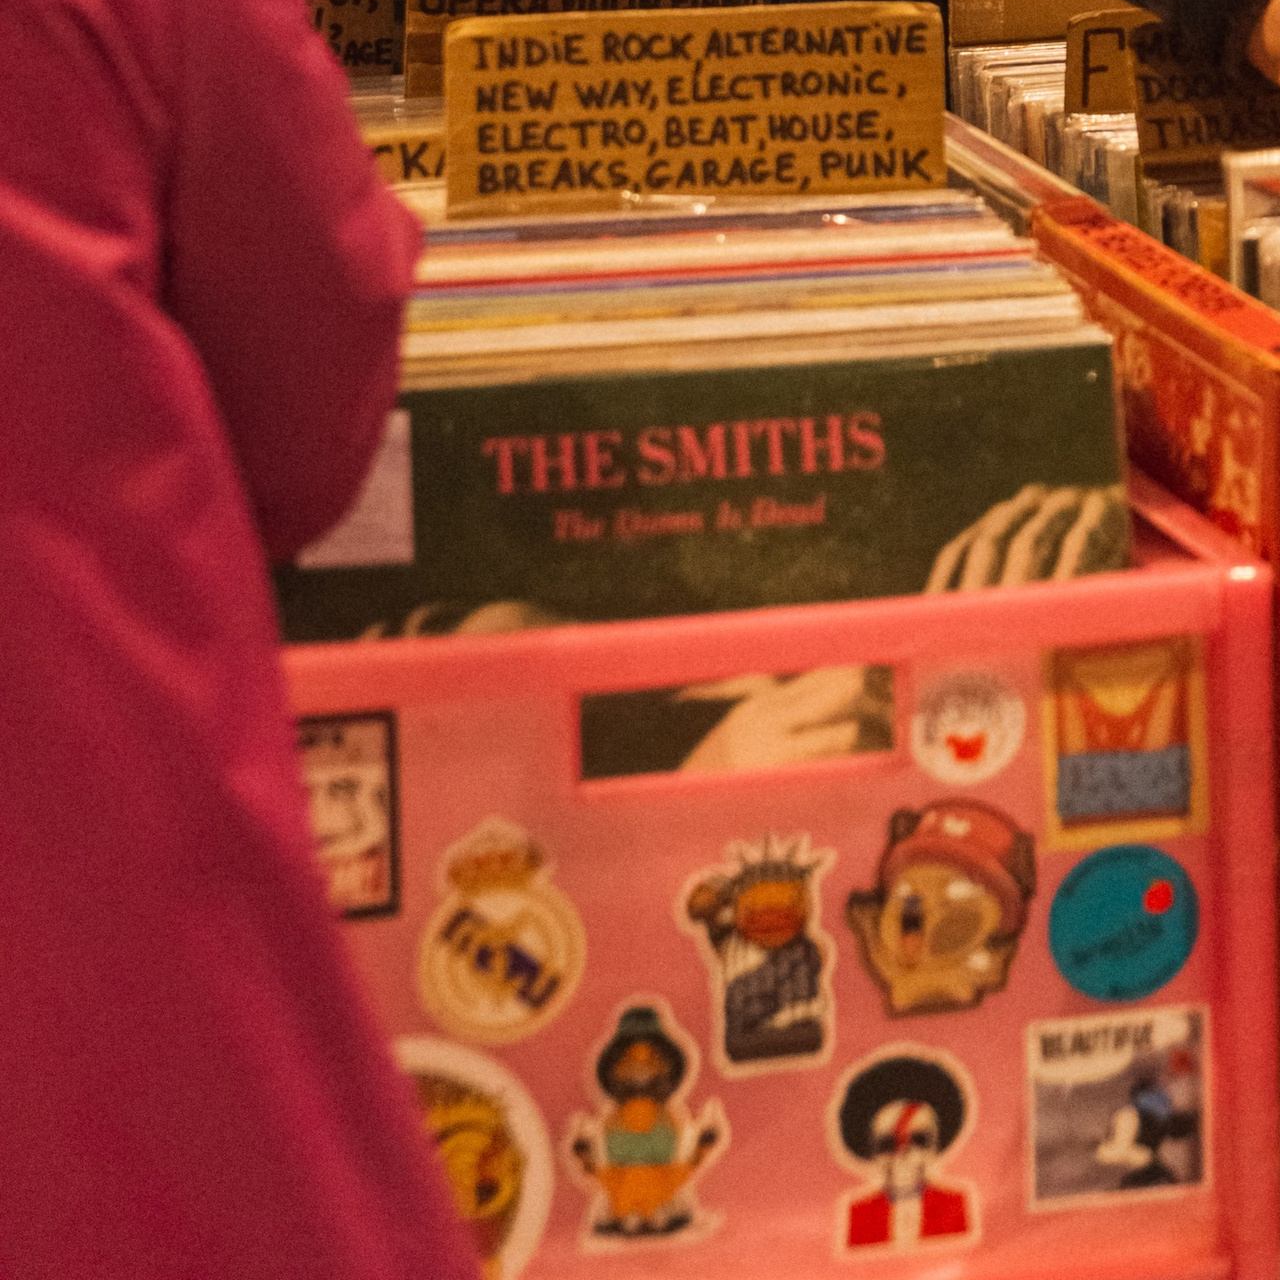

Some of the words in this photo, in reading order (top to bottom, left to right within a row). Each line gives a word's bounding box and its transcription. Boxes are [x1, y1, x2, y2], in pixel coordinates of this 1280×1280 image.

[475, 80, 559, 114] NEW
[572, 77, 659, 112] WAY,
[476, 117, 659, 156] ELECTRO,
[664, 113, 767, 152] BEAT,
[768, 110, 895, 142] HOUSE,
[477, 158, 643, 195] BREAKS,
[644, 152, 812, 190] GARAGE,
[820, 148, 932, 184] PUNK
[481, 427, 626, 496] THE
[636, 410, 888, 487] SMITHS
